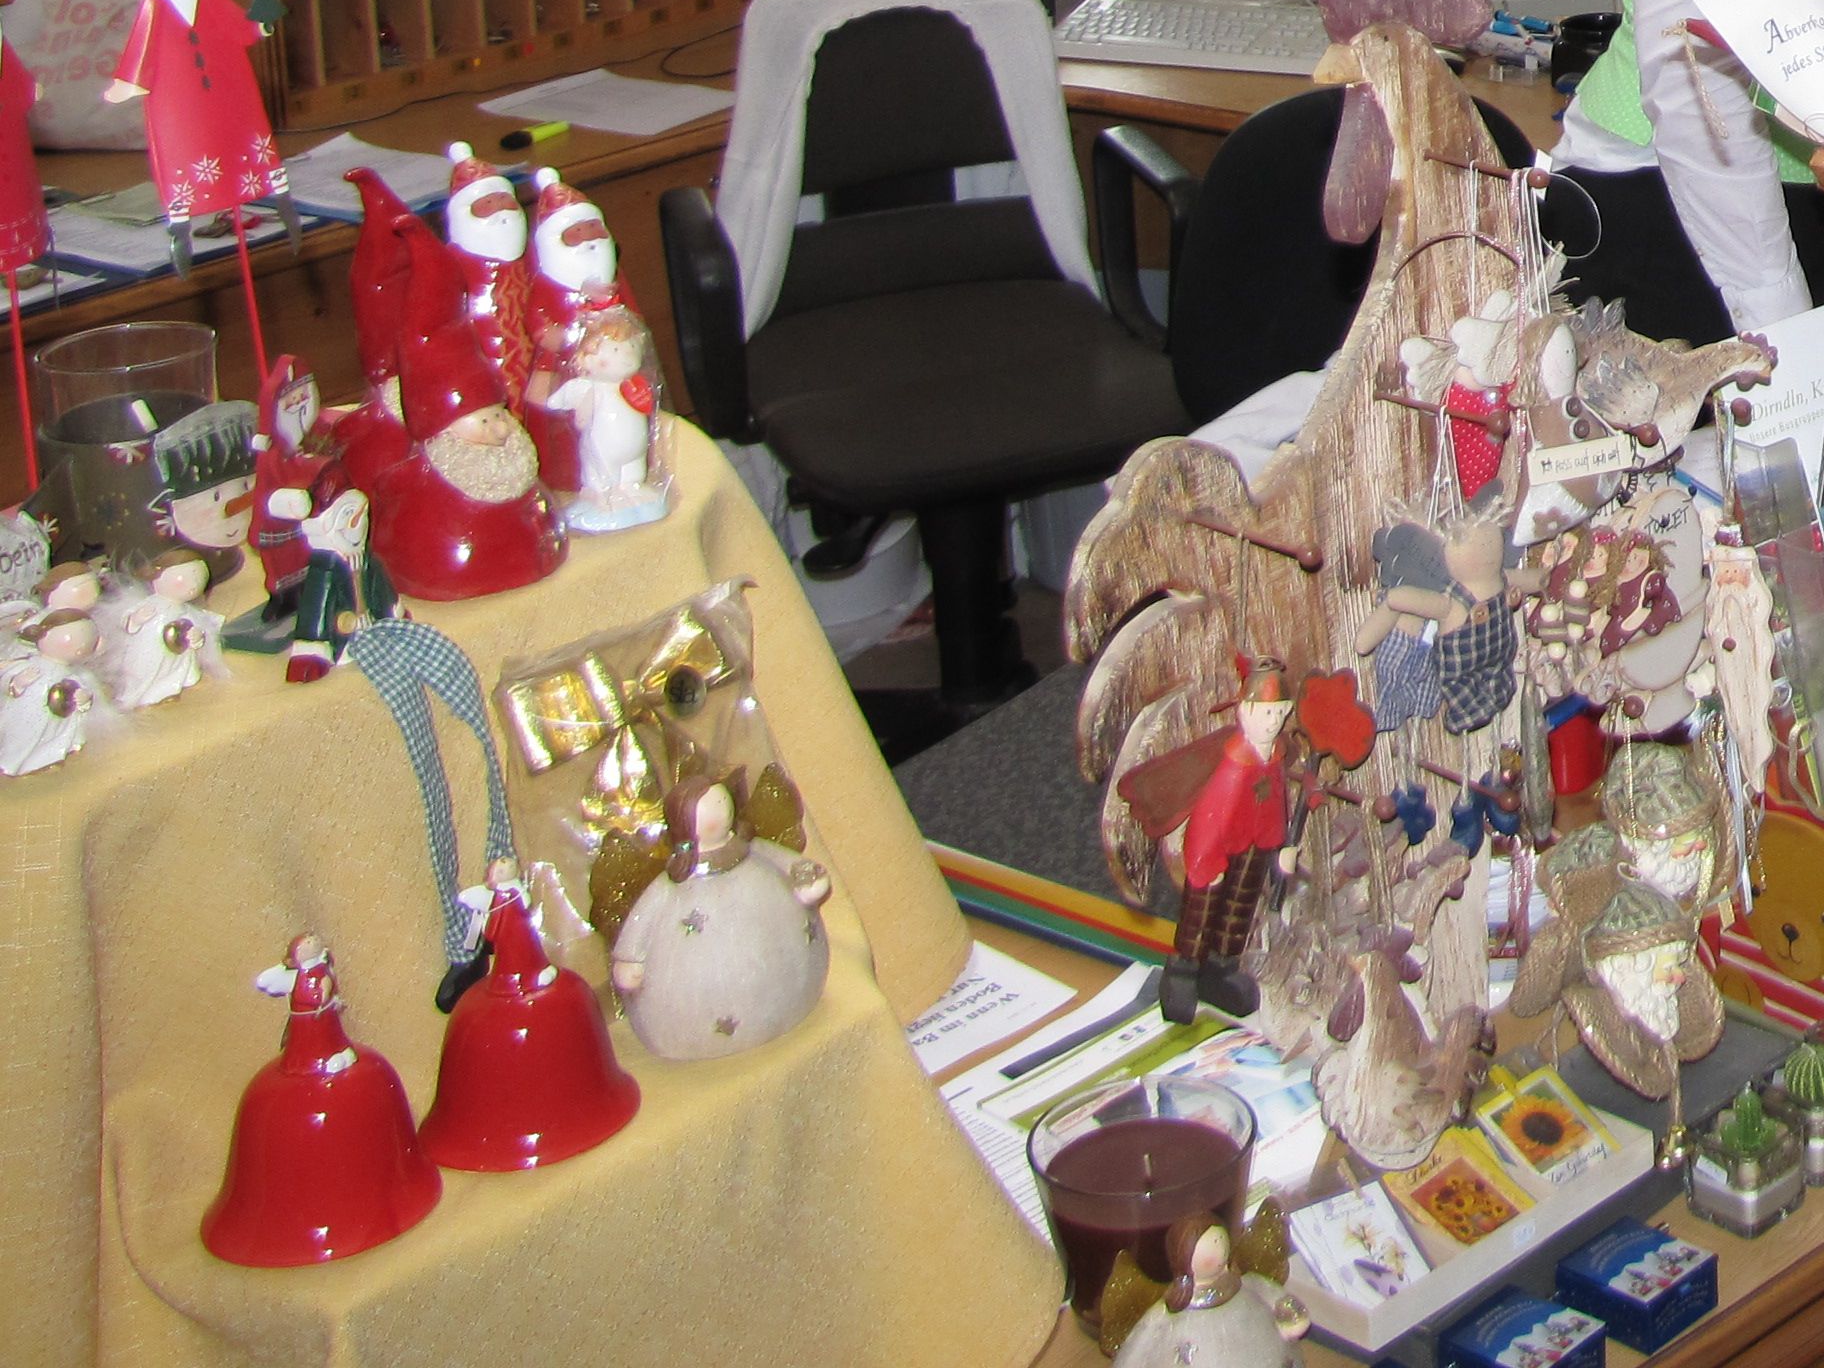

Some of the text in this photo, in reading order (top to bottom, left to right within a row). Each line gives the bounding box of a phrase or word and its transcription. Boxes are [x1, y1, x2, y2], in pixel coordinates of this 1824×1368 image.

[1780, 53, 1814, 81] jedes
[1751, 390, 1809, 420] Dirndln,
[944, 982, 1002, 1012] Boden
[966, 993, 1020, 1020] Wenn
[939, 1020, 963, 1033] im
